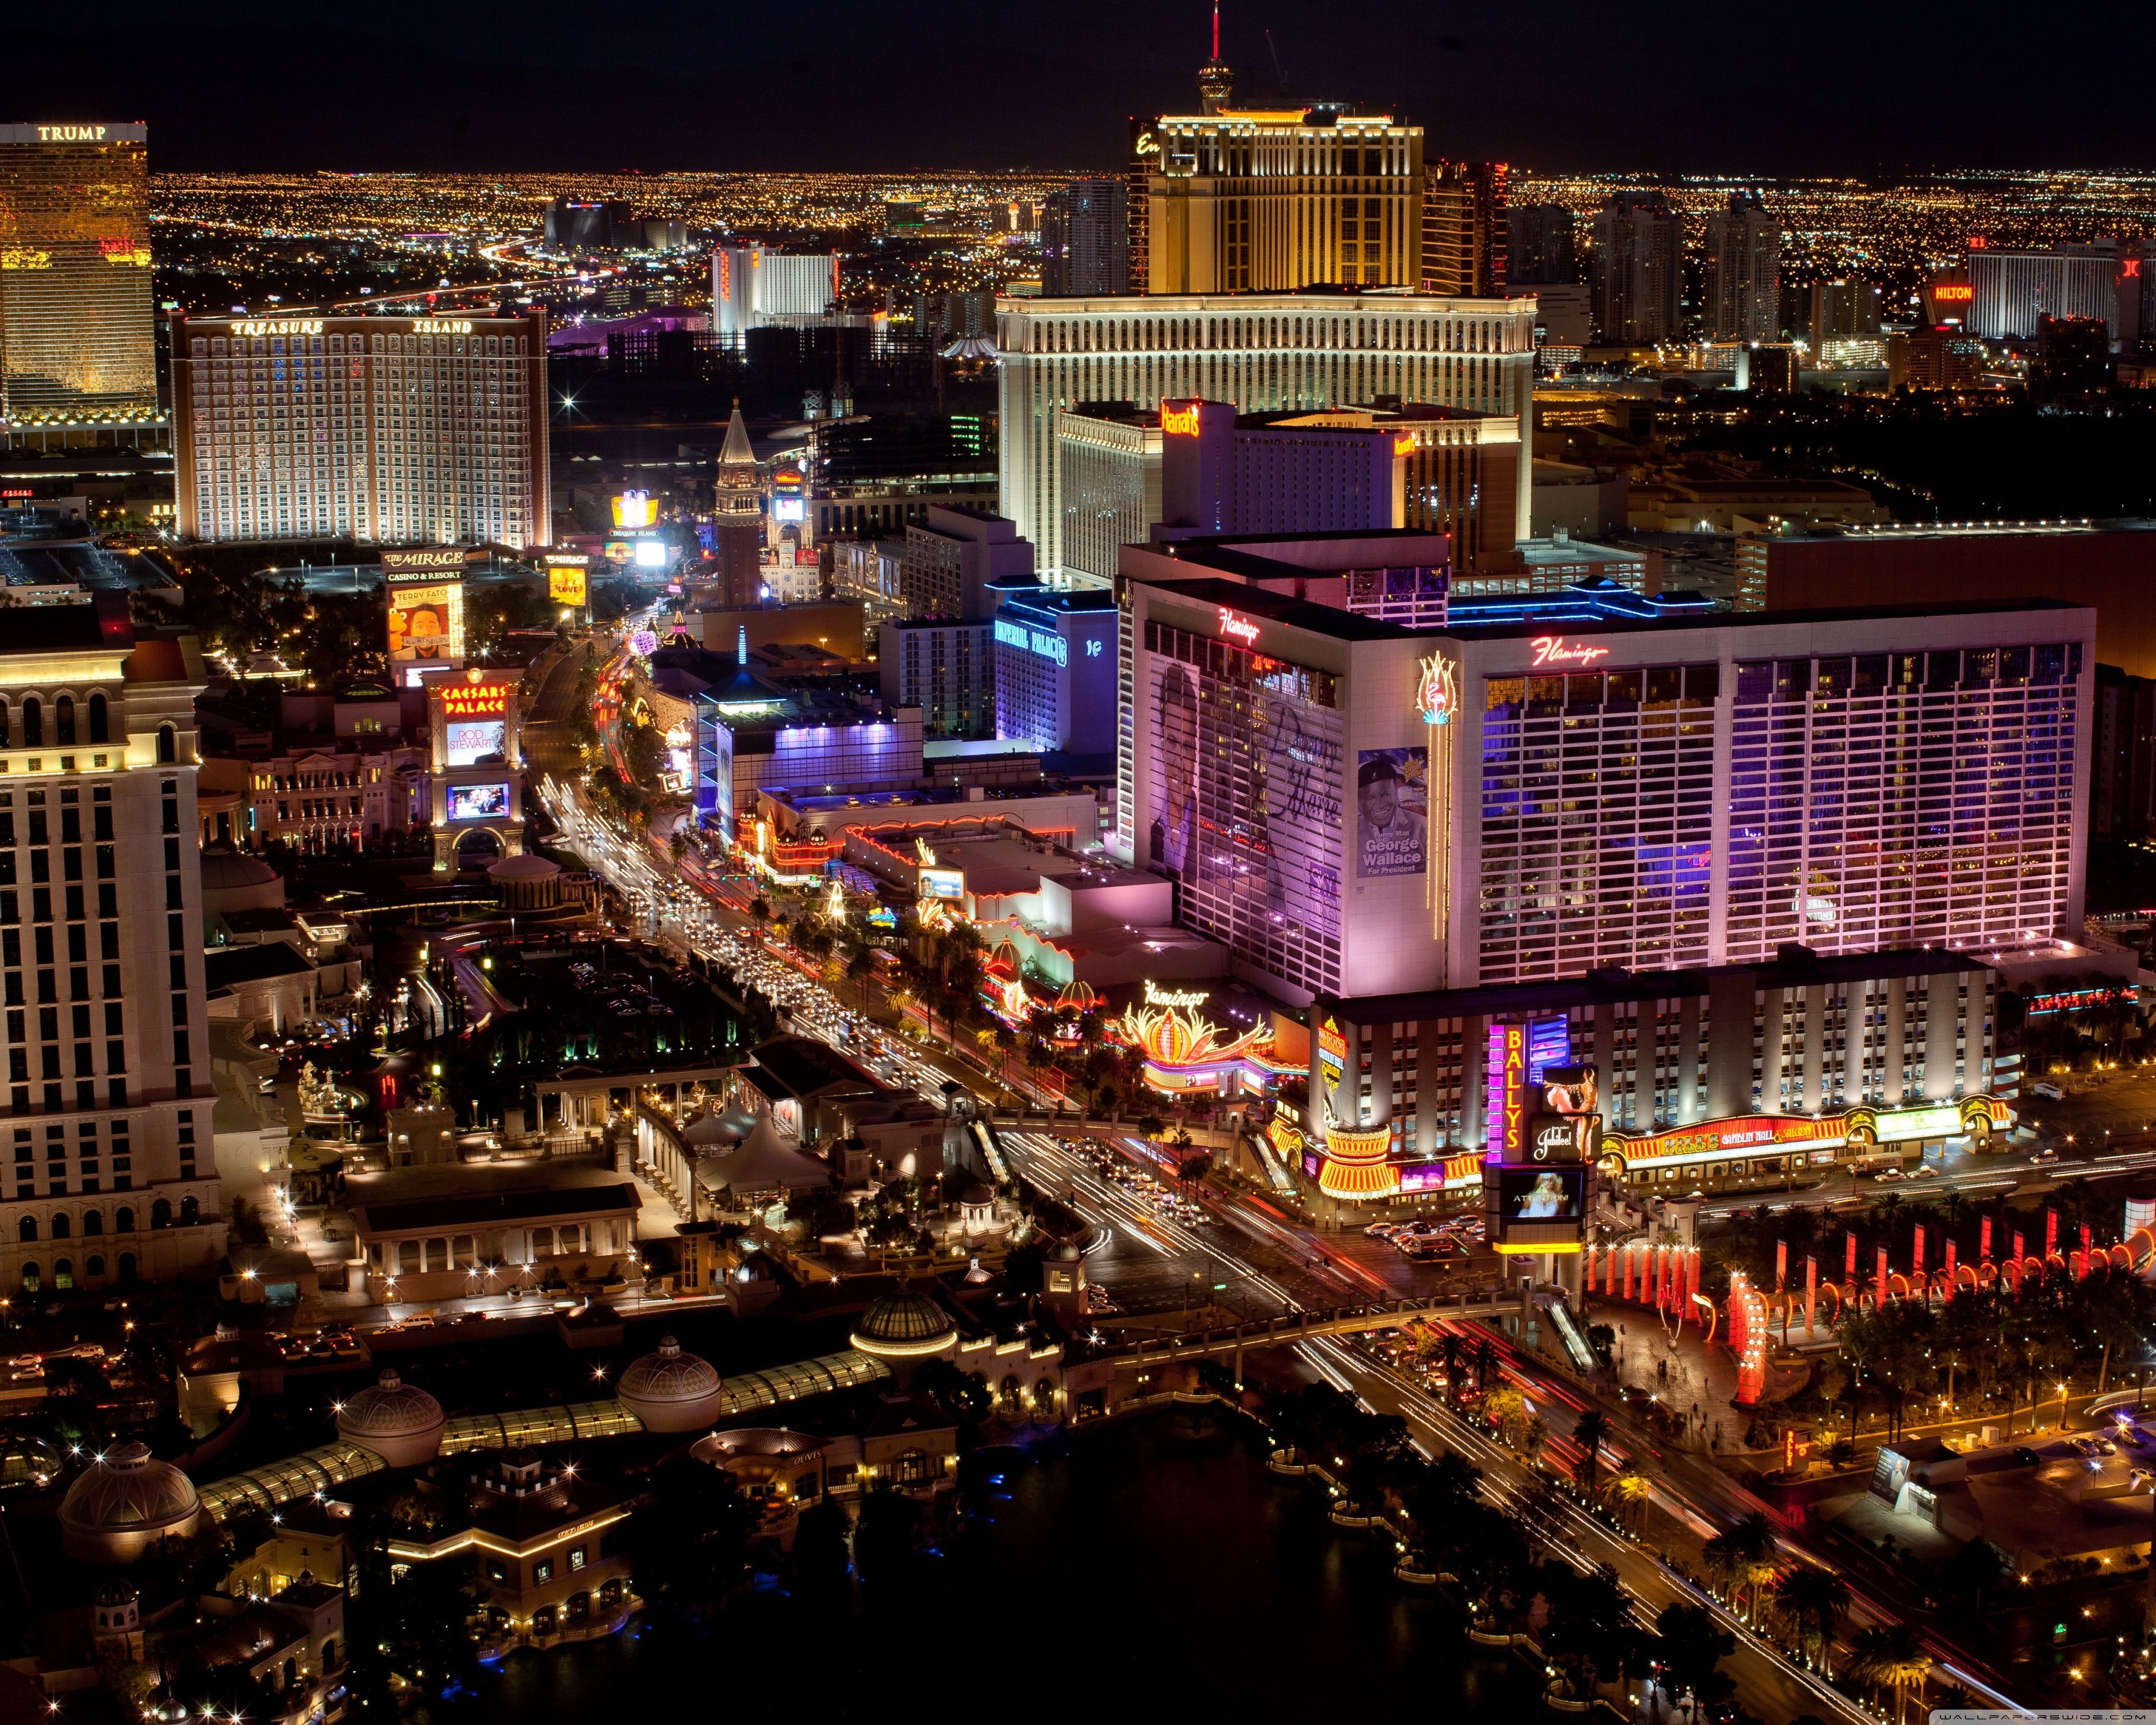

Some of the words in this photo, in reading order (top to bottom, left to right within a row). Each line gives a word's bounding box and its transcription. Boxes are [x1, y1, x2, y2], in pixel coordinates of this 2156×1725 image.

[38, 126, 106, 140] TRUMP
[1935, 287, 1972, 299] HILTON
[231, 321, 323, 336] TREASURE
[413, 320, 472, 334] ISLAND
[402, 552, 463, 566] MIRAGE
[555, 555, 588, 564] MIRAGE
[397, 592, 424, 601] TERRY
[427, 589, 447, 597] FATO
[1219, 607, 1260, 646] Flamingo
[995, 620, 1029, 649] IMPERIAL
[1031, 631, 1057, 659] PALAC
[1530, 636, 1609, 666] Flamingo
[442, 687, 506, 700] CAESARS
[446, 700, 504, 714] PALACE
[458, 730, 484, 740] ROD
[450, 739, 493, 750] STEWART
[1365, 838, 1419, 852] George
[1363, 852, 1421, 867] Wallace
[1382, 865, 1415, 873] President
[1145, 979, 1210, 1014] Flamingo
[1534, 1127, 1571, 1160] Jubilee!
[1664, 1132, 1719, 1155] BILL'S
[1756, 1129, 1774, 1141] HALL
[1774, 1129, 1782, 1143] &
[1782, 1125, 1811, 1137] SALOON
